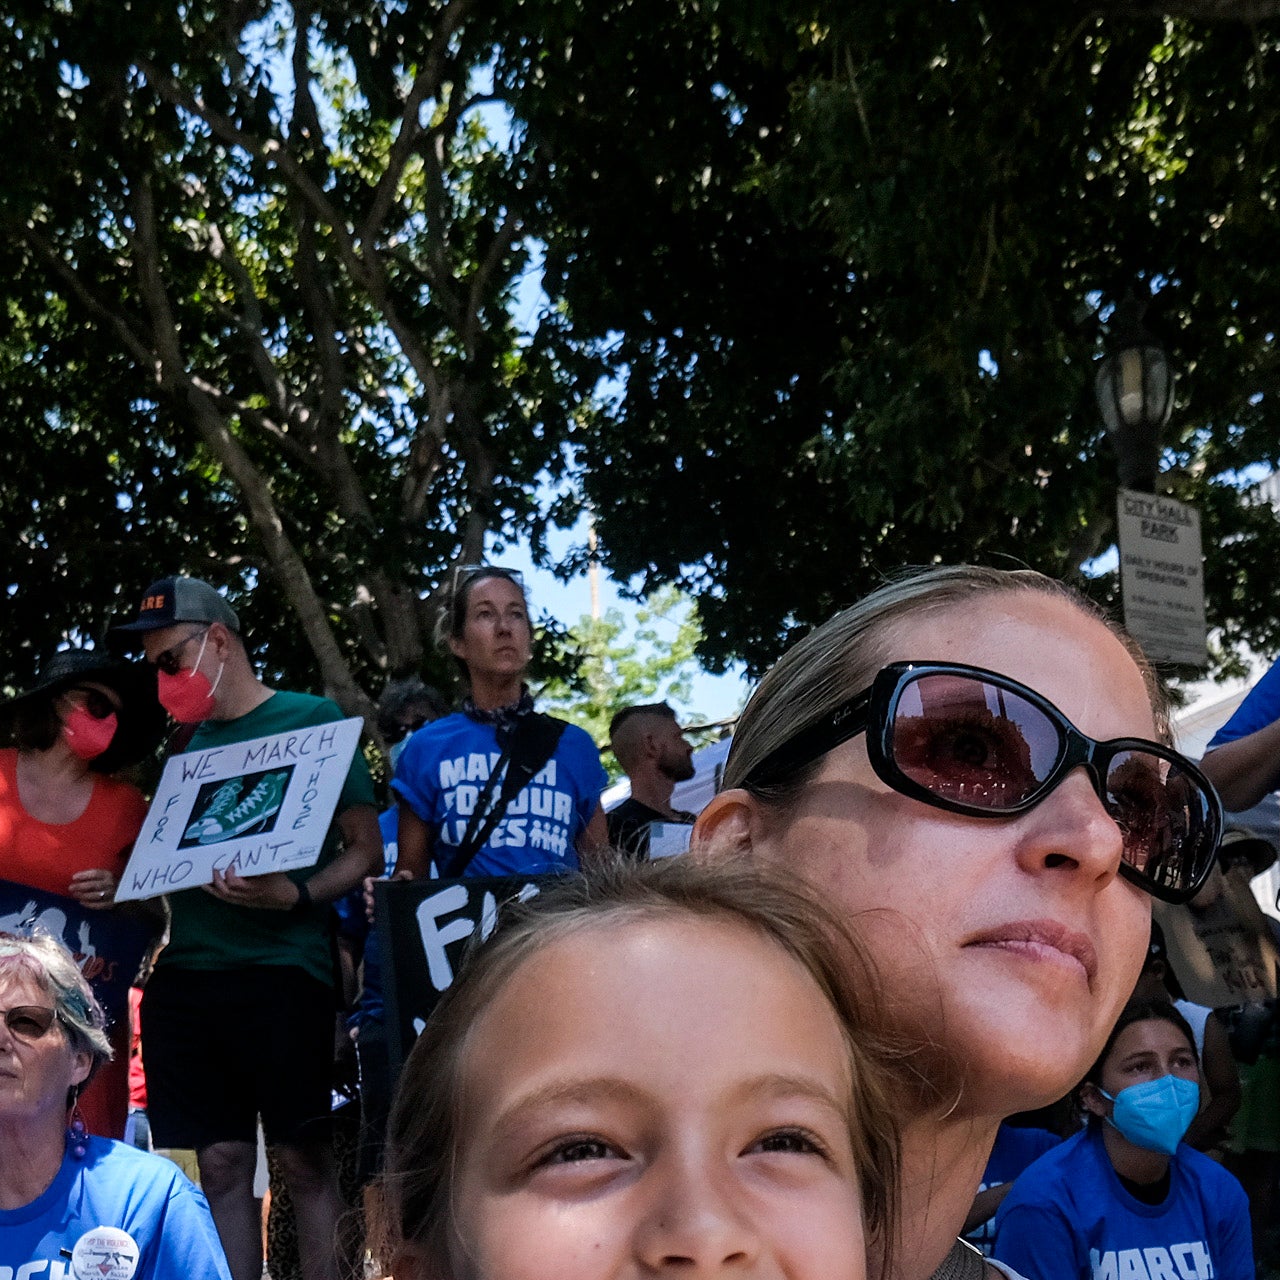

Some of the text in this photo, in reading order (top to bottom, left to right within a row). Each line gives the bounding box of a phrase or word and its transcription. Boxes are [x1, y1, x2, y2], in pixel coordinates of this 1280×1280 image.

[1140, 519, 1179, 540] PARK
[181, 727, 338, 784] WE MARCH
[440, 752, 556, 789] MAH
[291, 754, 338, 831] THOSE
[150, 794, 180, 844] FOR
[131, 860, 194, 892] WHO
[212, 841, 295, 872] CAN'T
